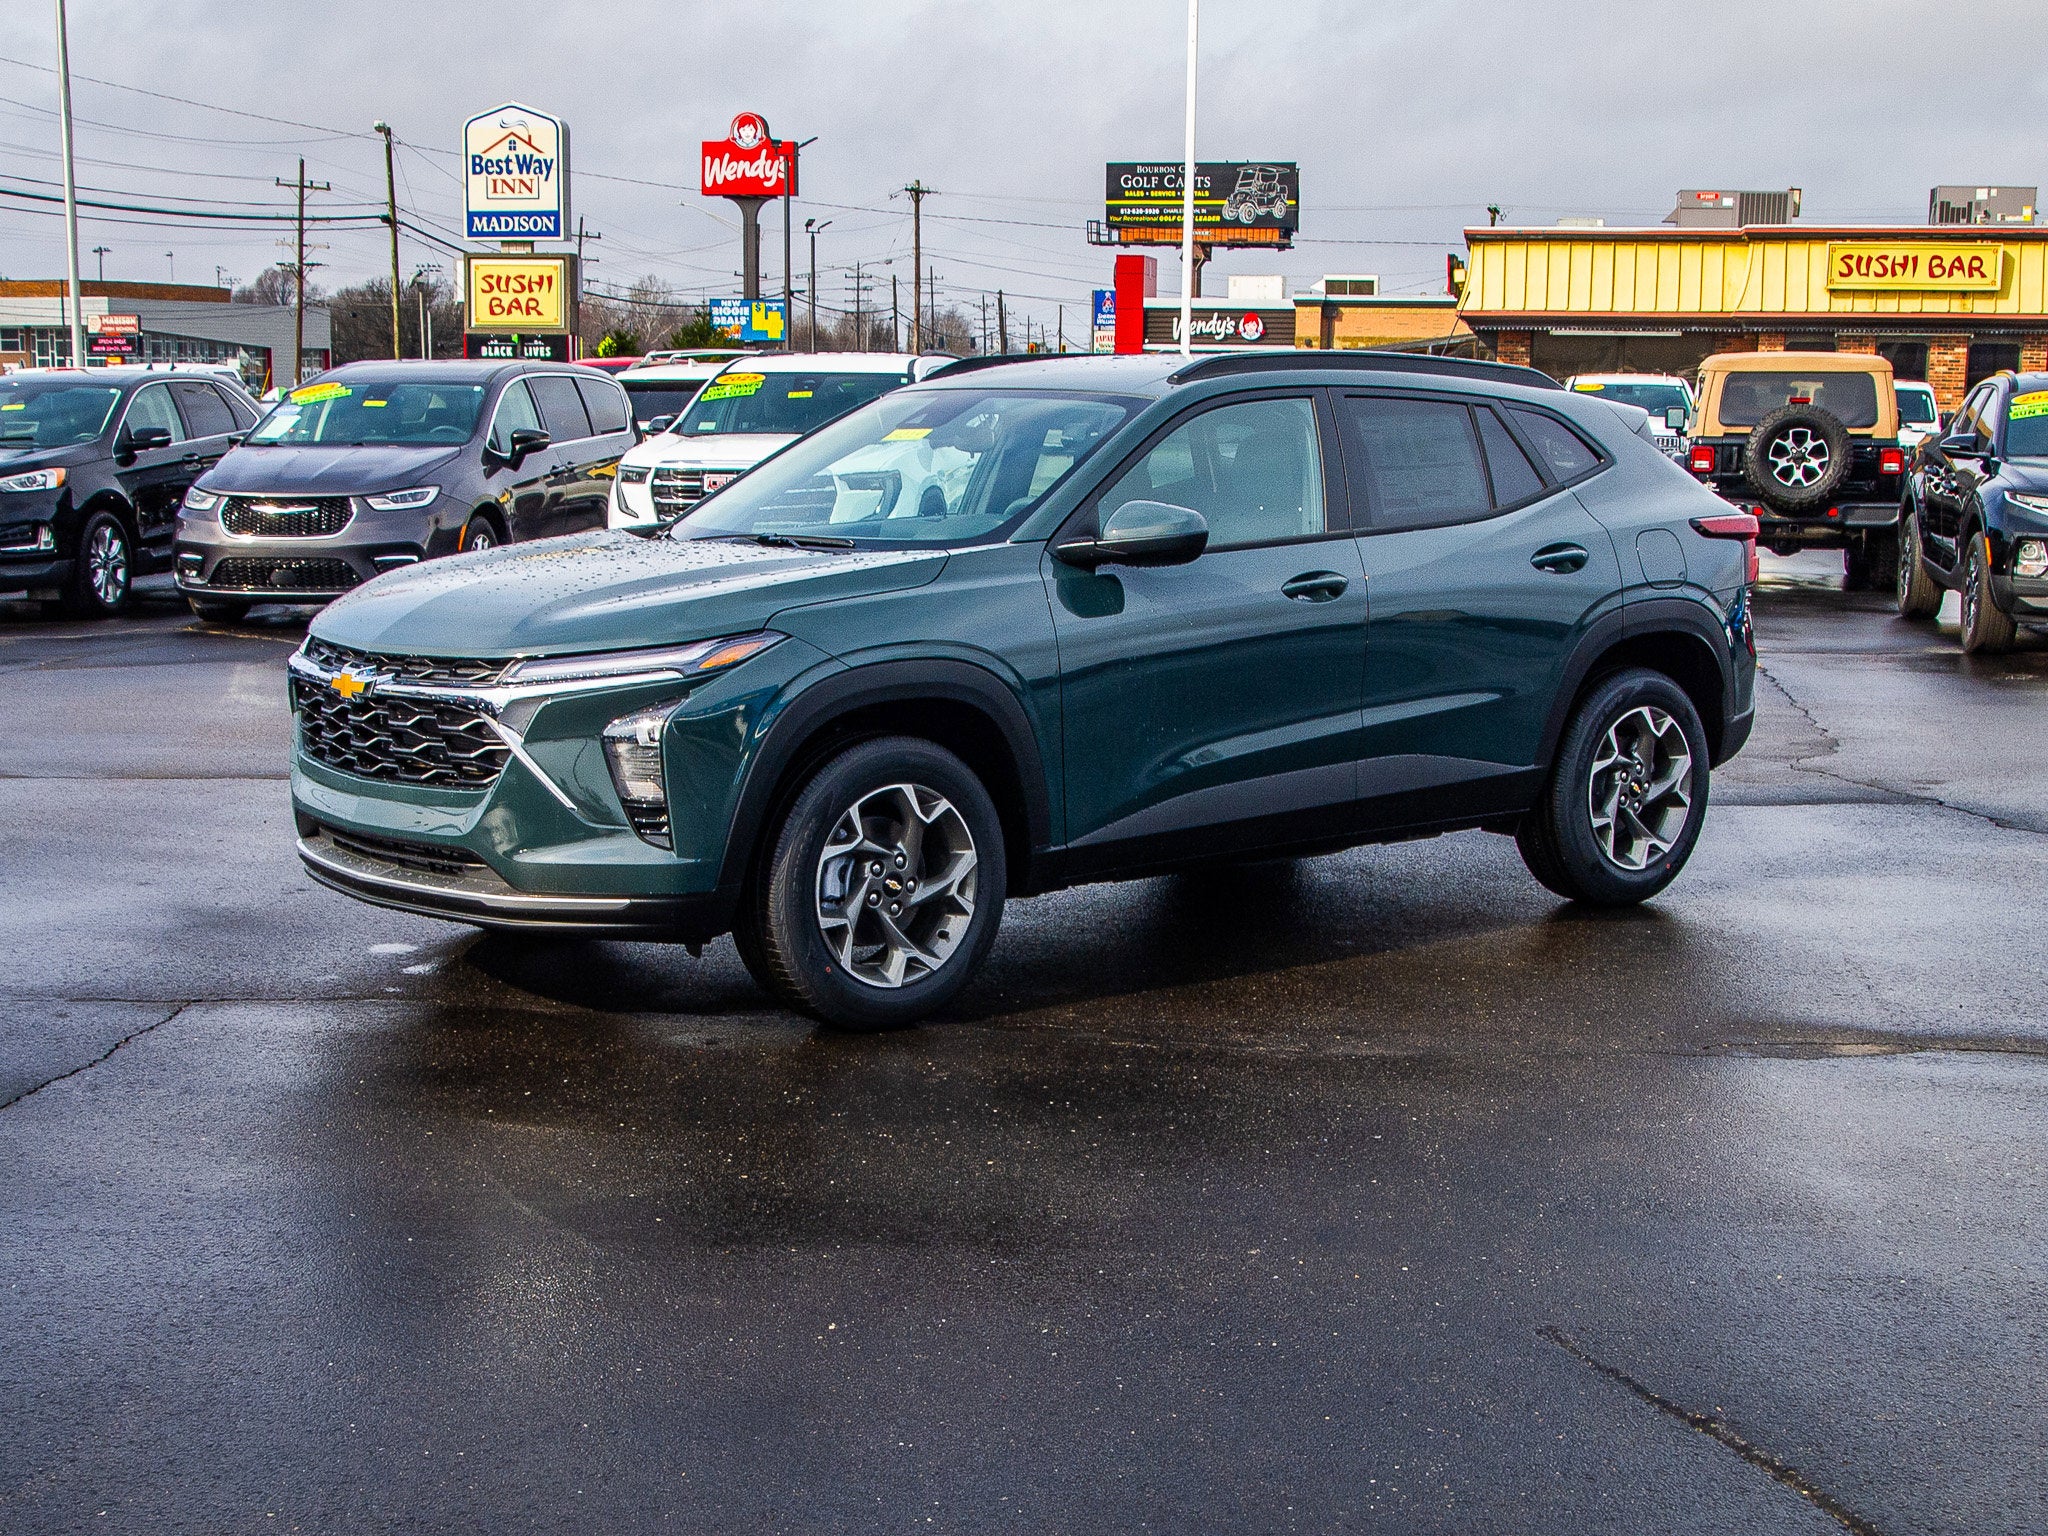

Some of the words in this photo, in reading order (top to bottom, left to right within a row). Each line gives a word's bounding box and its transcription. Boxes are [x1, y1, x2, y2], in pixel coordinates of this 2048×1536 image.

[471, 154, 513, 175] Best
[515, 154, 554, 181] Way
[1137, 165, 1175, 173] BOURBON
[1179, 165, 1198, 173] CY
[491, 178, 534, 194] INN
[1120, 175, 1158, 188] GOLF
[1164, 175, 1210, 188] CATS
[472, 216, 555, 232] MADISON
[1838, 254, 1918, 278] SUSHI
[1928, 254, 1987, 278] BAR
[480, 274, 553, 294] SUSHI
[488, 297, 544, 316] BAR
[481, 346, 513, 357] BLACK
[524, 346, 552, 357] LIVES
